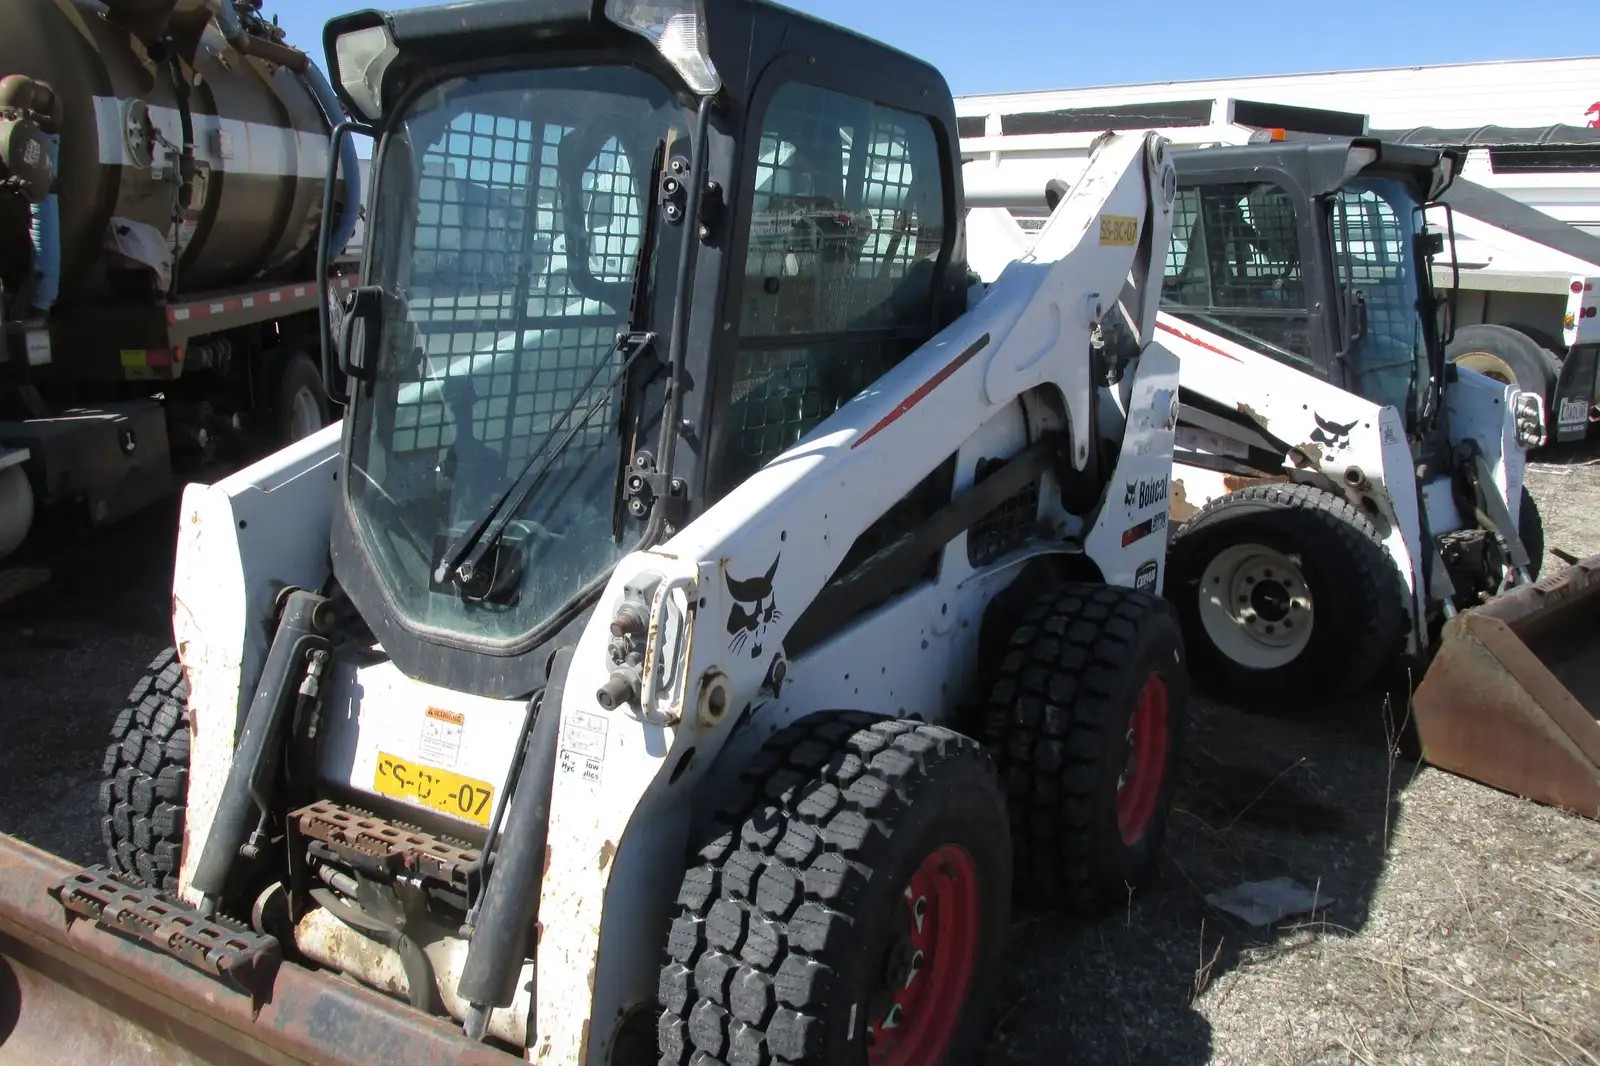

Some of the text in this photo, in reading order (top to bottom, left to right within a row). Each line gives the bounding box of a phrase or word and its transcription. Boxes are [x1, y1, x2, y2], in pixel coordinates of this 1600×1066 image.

[1100, 219, 1137, 241] SS-BC-07
[1138, 473, 1168, 509] Bobcat
[434, 710, 462, 723] WARNING
